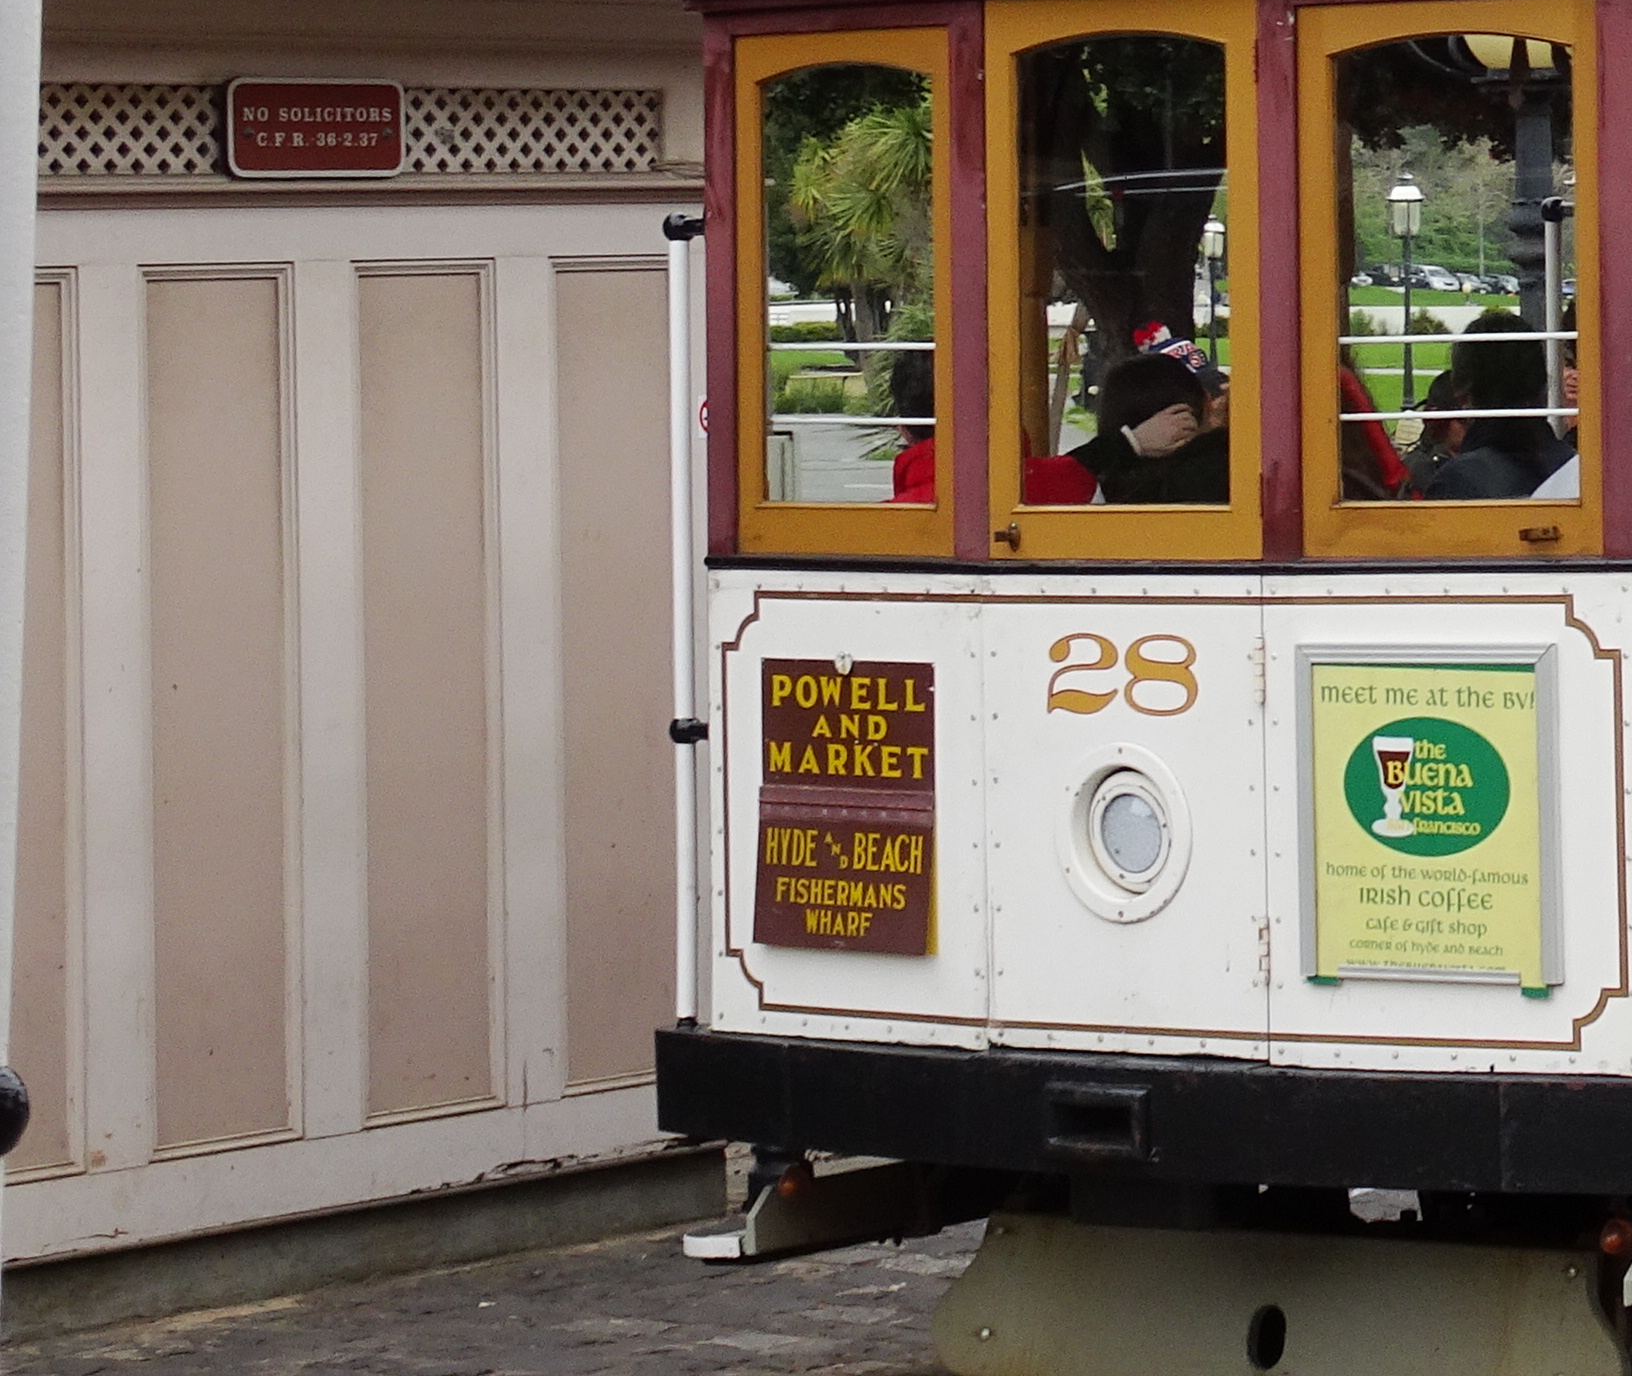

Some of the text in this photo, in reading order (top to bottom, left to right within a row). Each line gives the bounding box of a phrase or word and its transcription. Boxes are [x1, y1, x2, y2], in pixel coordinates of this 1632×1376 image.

[243, 107, 393, 122] NO SOLICITORS
[1047, 632, 1198, 716] 28
[772, 675, 926, 712] POWELL
[812, 714, 888, 741] AND
[769, 741, 929, 779] MARKET
[766, 827, 819, 867] HYDE
[853, 832, 924, 874] BEACH
[776, 877, 907, 910] FISHERMANS
[805, 909, 873, 936] WHARF
